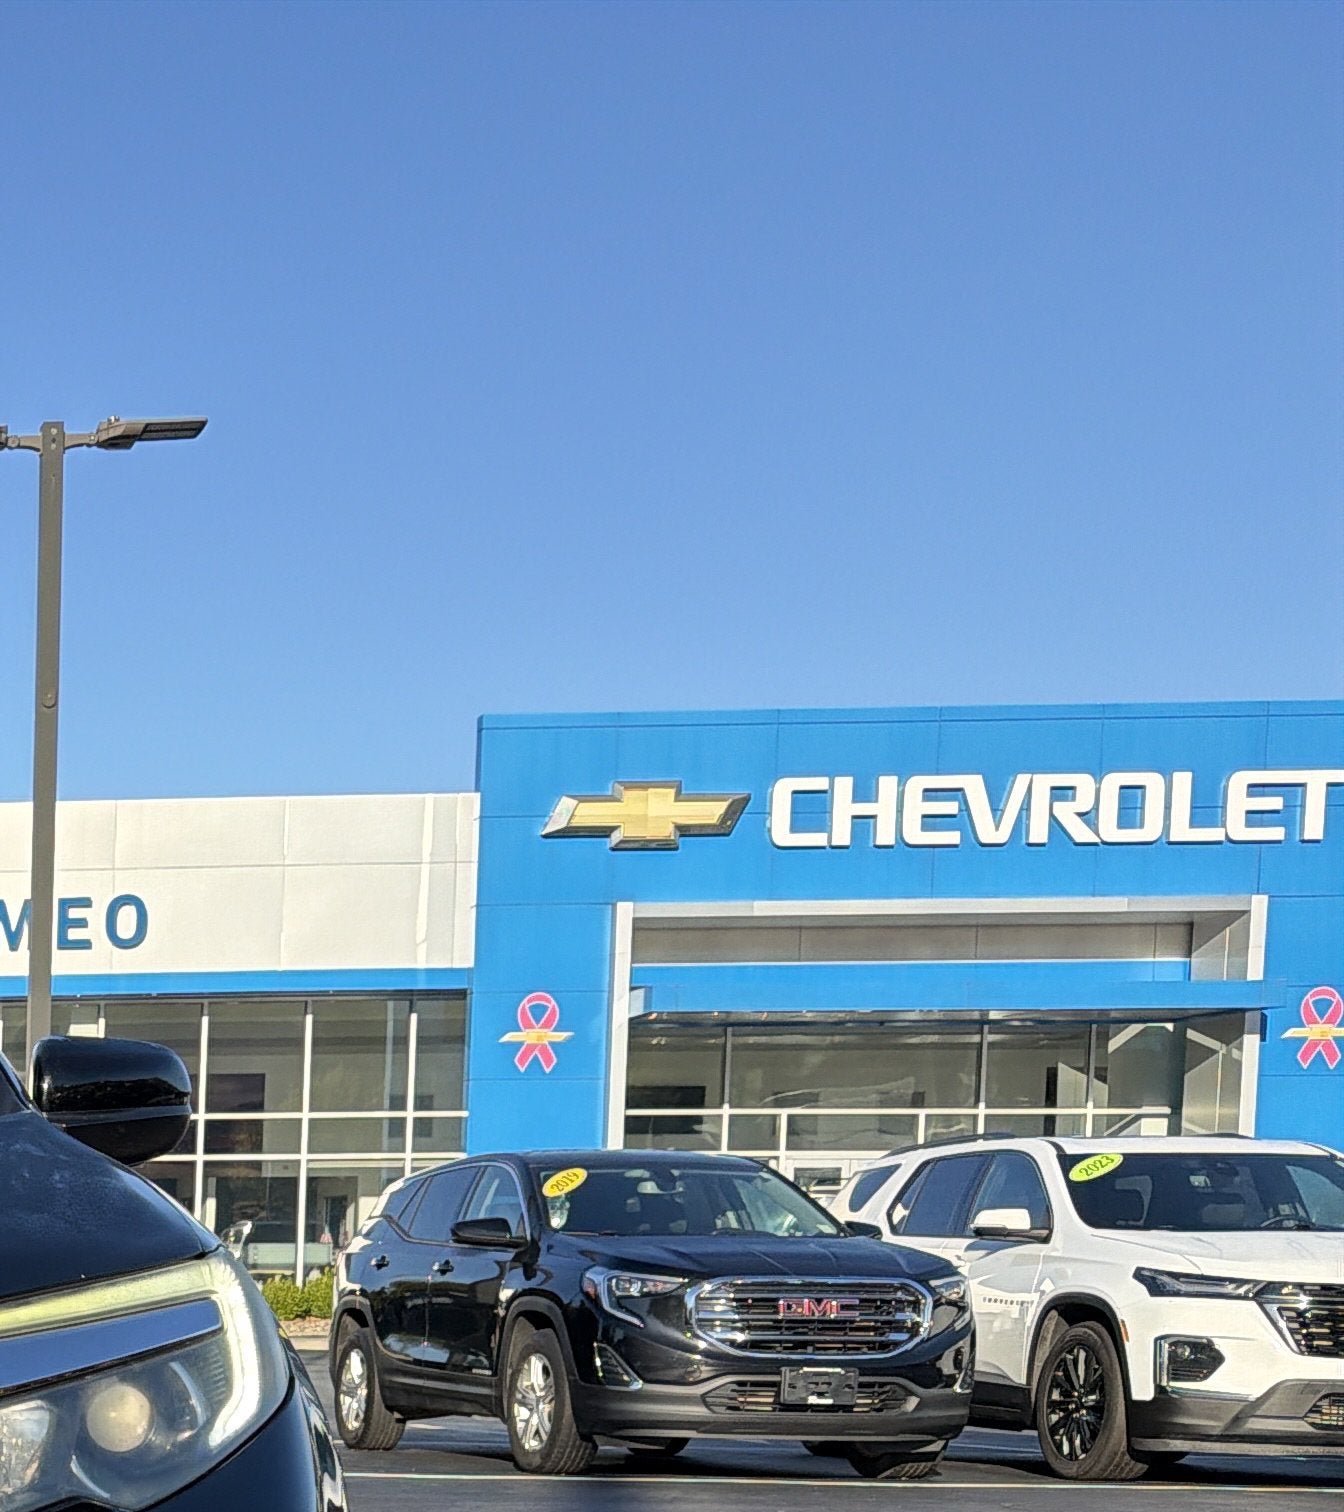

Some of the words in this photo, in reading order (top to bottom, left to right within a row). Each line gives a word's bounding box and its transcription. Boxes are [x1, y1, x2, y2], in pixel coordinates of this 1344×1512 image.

[769, 769, 1344, 848] CHEVROLET
[1079, 1156, 1115, 1177] 2023
[551, 1172, 580, 1192] 2019
[778, 1299, 859, 1318] GMC
